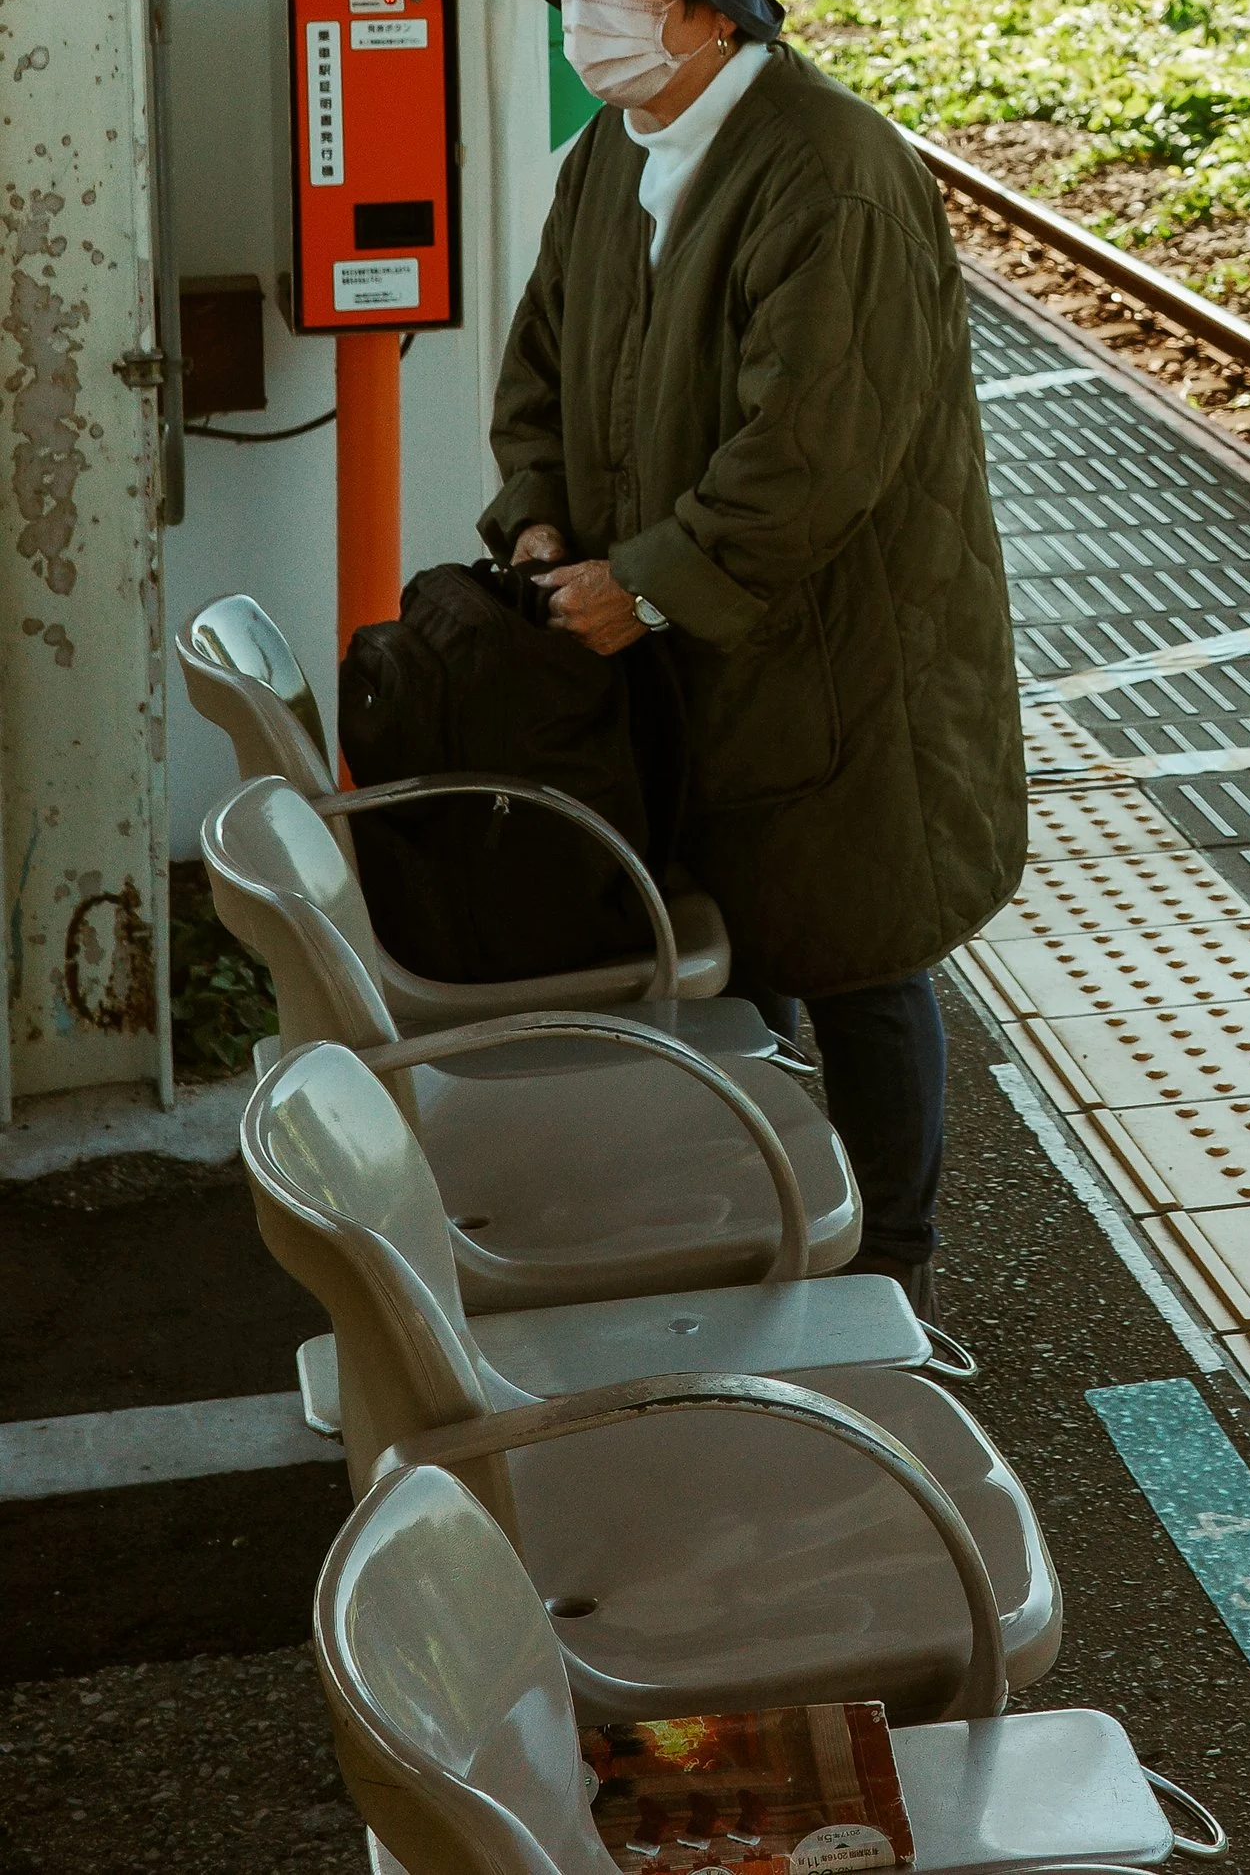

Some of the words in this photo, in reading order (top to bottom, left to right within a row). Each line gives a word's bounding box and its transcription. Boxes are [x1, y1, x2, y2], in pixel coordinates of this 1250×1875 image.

[318, 29, 334, 178] 乗車駅証明書発行機
